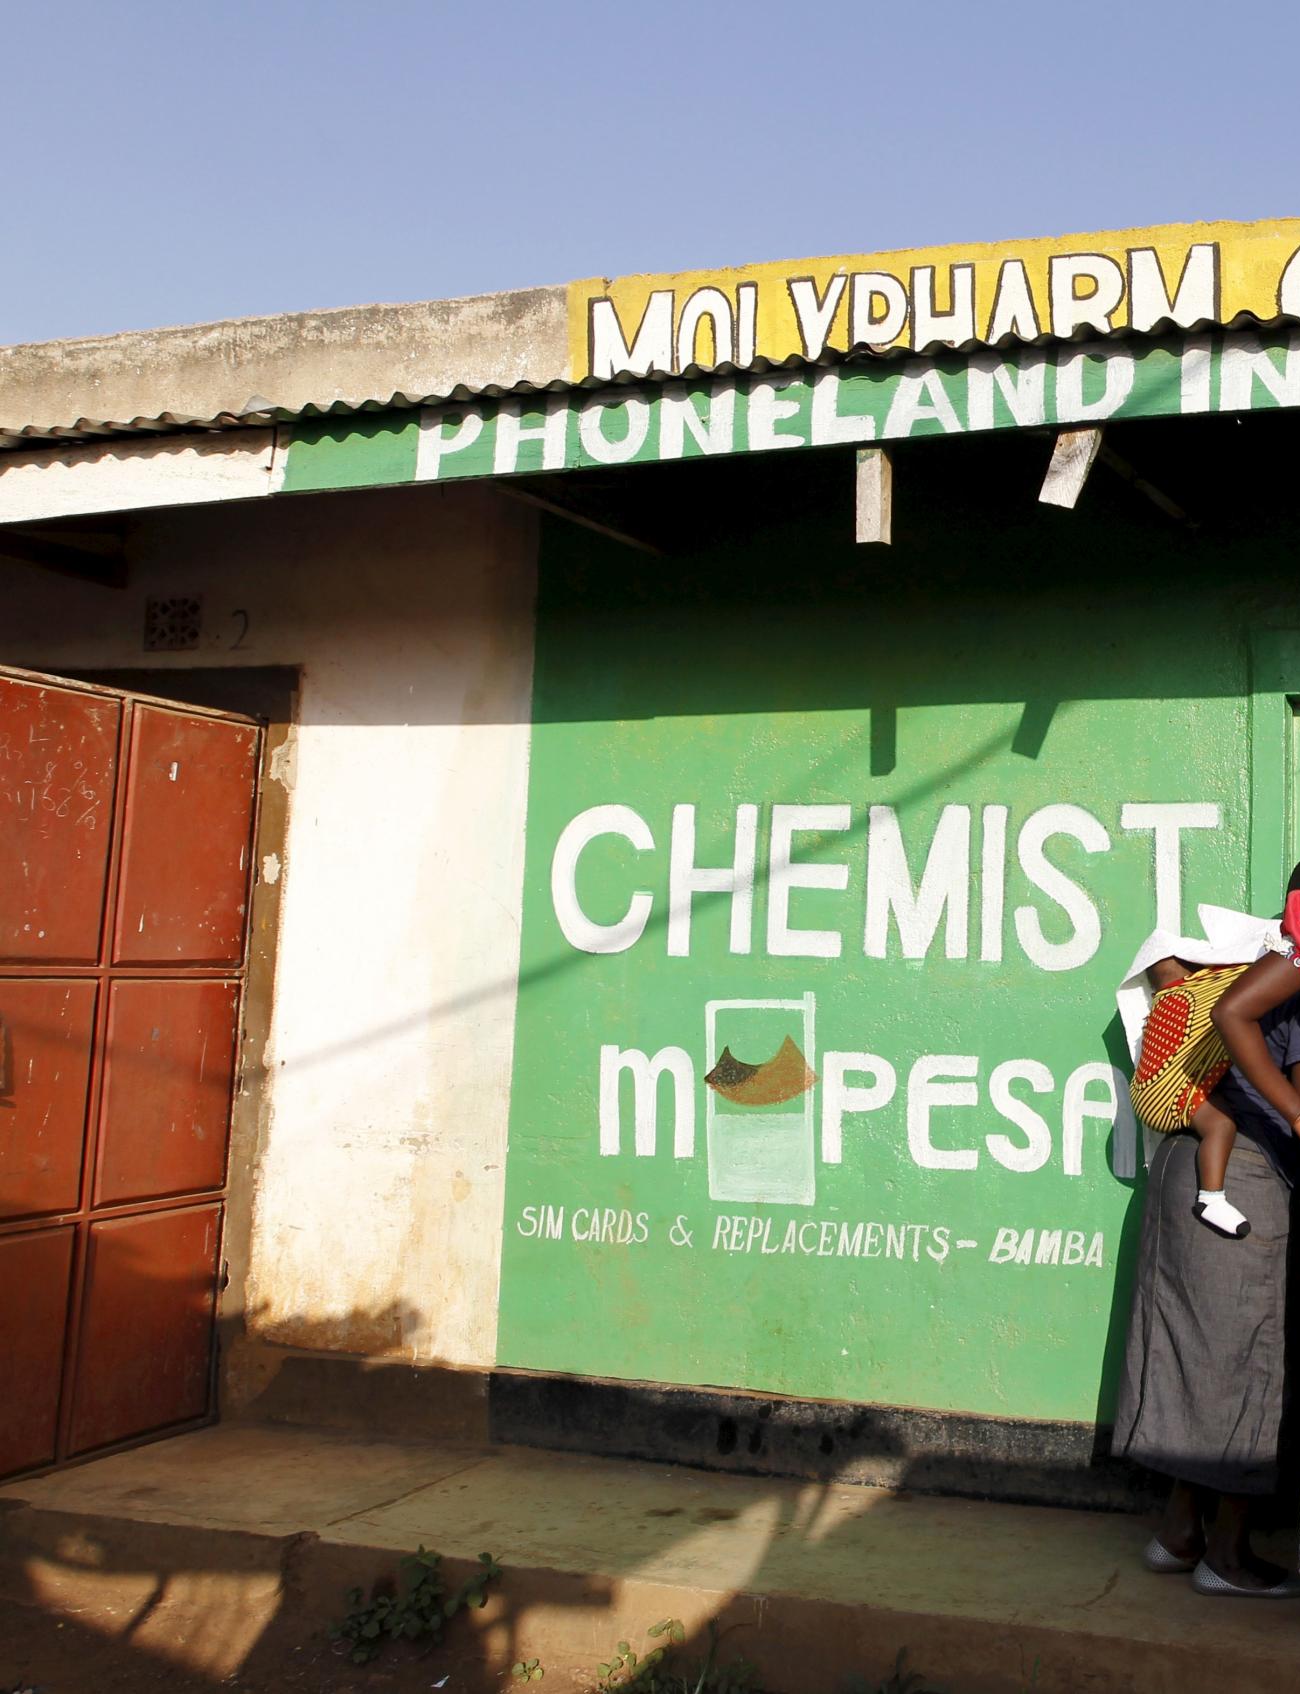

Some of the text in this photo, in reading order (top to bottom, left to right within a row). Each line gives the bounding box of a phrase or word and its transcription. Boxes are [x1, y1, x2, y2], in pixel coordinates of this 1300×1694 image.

[551, 802, 1220, 971] CHEMIST
[821, 1050, 1136, 1178] PESA
[517, 1205, 564, 1240] SIM
[571, 1207, 649, 1244] CARDS
[669, 1214, 693, 1248] &
[988, 1227, 1104, 1268] BAMBA
